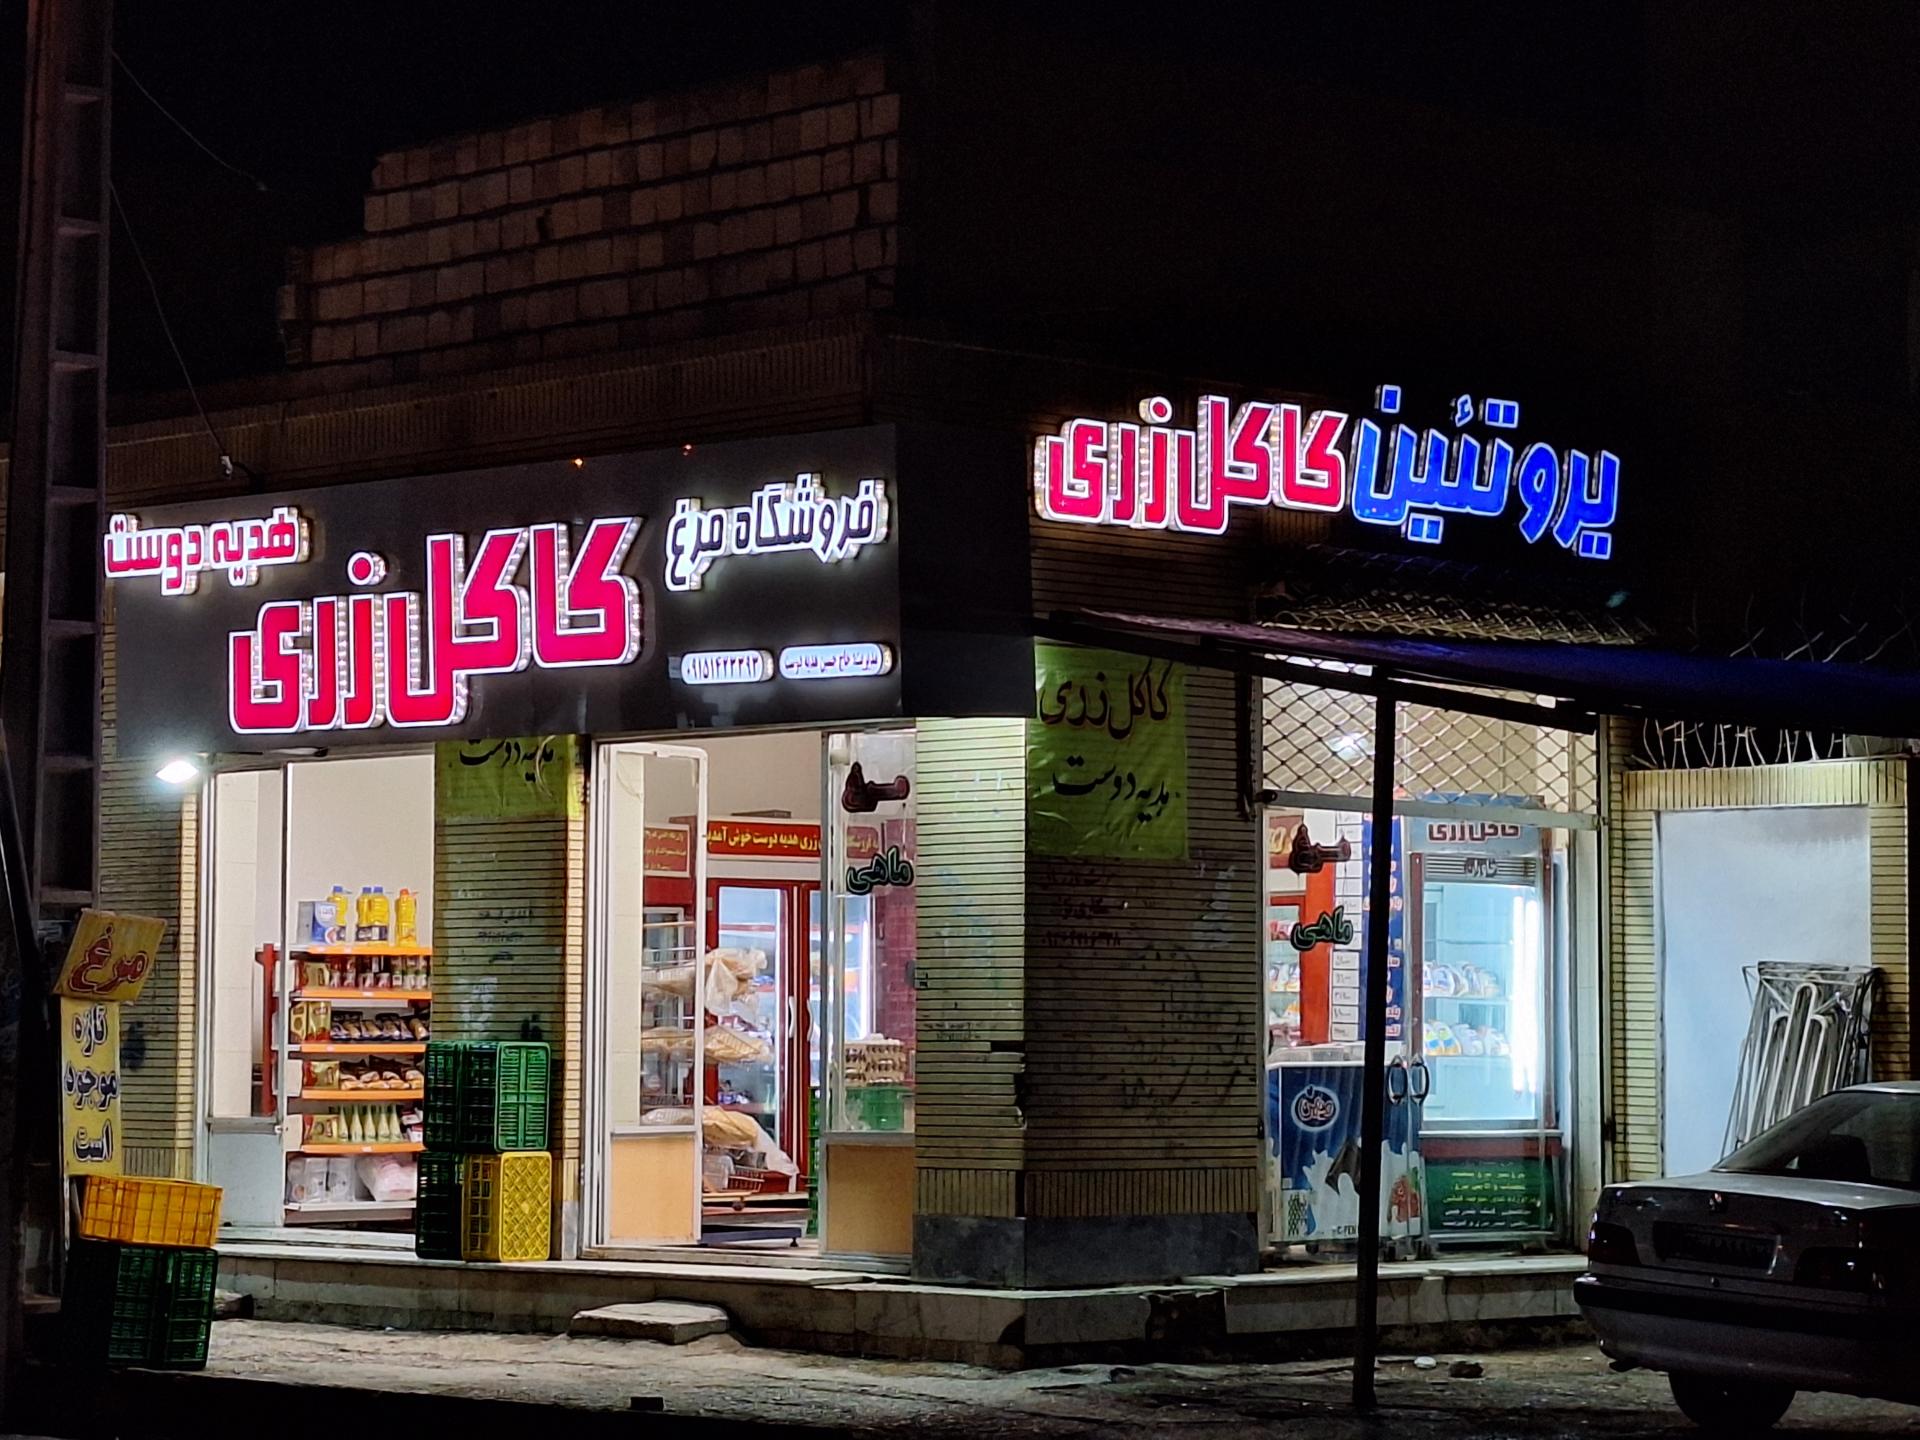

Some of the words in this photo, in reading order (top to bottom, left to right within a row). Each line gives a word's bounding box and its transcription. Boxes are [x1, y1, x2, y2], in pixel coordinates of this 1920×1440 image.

[1036, 396, 1174, 529] زری
[1173, 394, 1348, 535] کاکل
[211, 506, 305, 587] هدیه
[665, 497, 728, 592] مرغ
[730, 472, 885, 563] فروشگاه
[104, 513, 206, 596] دوست
[228, 551, 380, 735] زری
[384, 517, 640, 728] کاکل
[1038, 670, 1108, 727] زری
[1108, 656, 1173, 739] کاکل
[1051, 755, 1136, 801] دوست
[1136, 780, 1170, 823] هدیه
[752, 831, 778, 849] دوست
[778, 831, 799, 848] هدیه
[846, 845, 914, 896] ماهی
[68, 924, 150, 994] مرغ
[1290, 905, 1354, 951] ماهی
[72, 1002, 109, 1057] تازه
[64, 1061, 119, 1111] موجود
[73, 1119, 114, 1162] است
